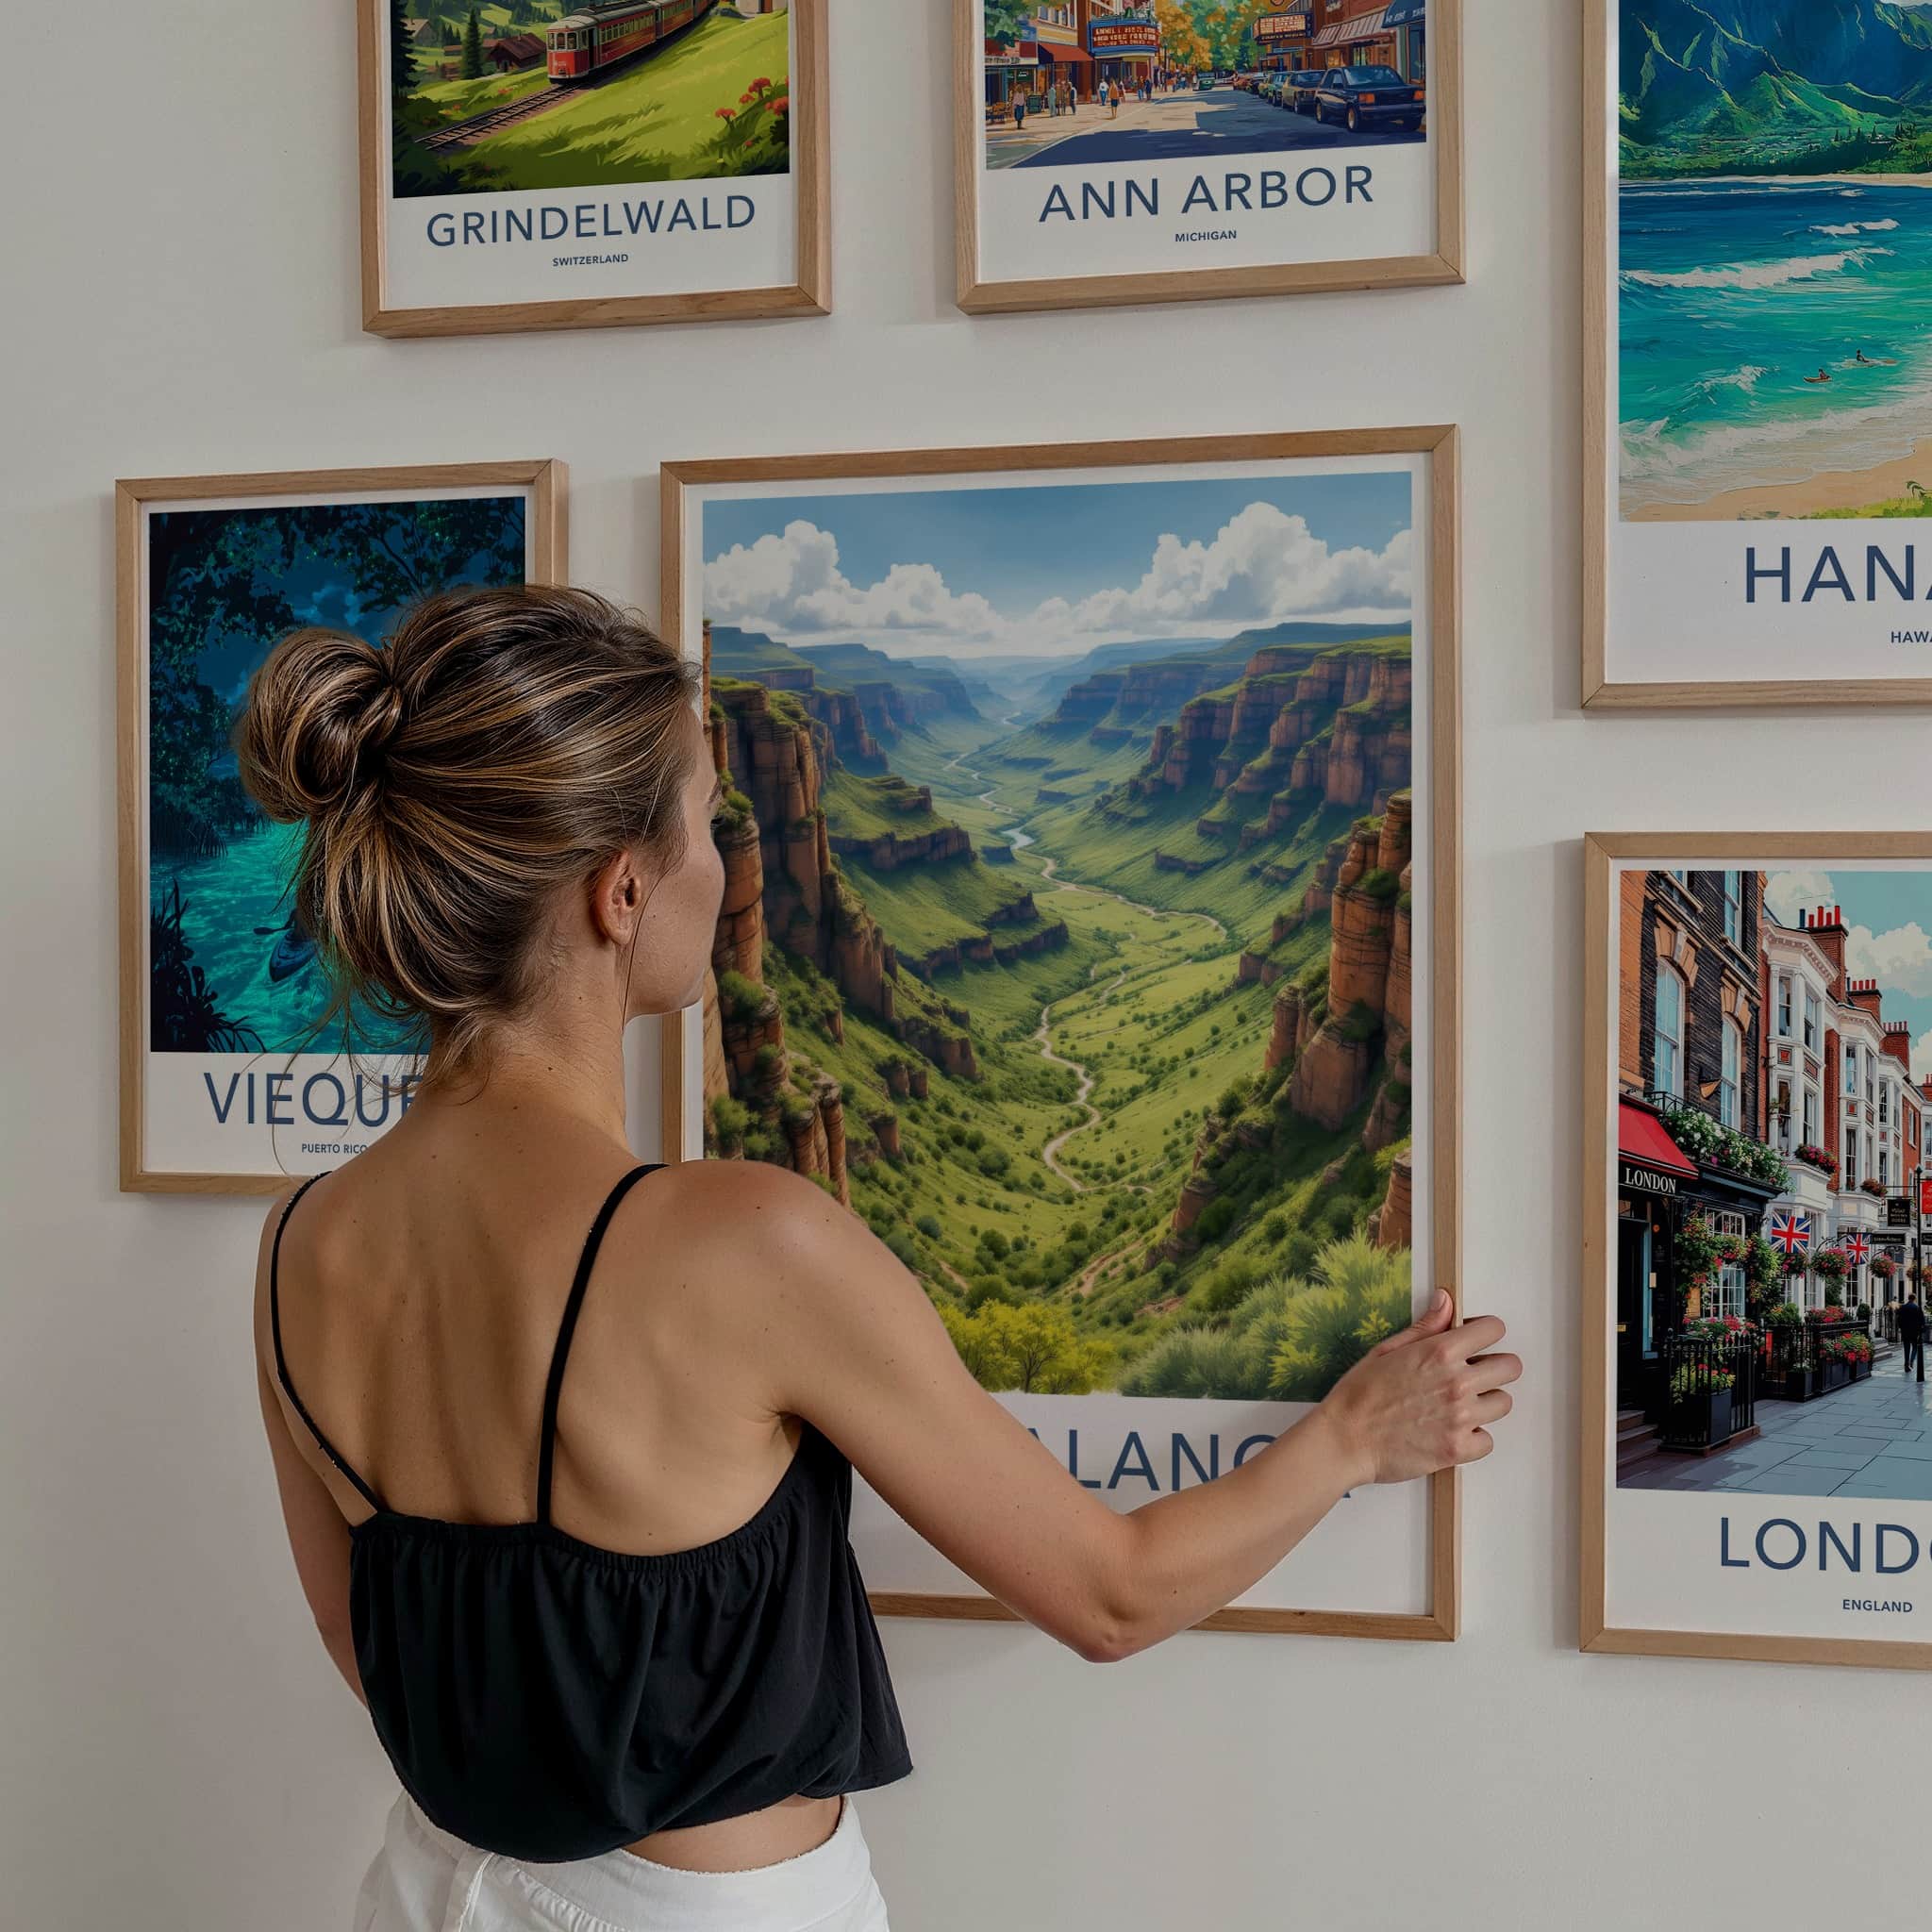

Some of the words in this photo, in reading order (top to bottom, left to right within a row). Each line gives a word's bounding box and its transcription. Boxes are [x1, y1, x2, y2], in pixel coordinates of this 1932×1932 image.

[1039, 177, 1159, 223] ANN
[1181, 165, 1374, 214] ARBOR
[426, 194, 756, 247] GRINDELWALD
[1174, 229, 1237, 242] MICHIGAN
[552, 253, 629, 267] SWITZERLAND
[1746, 544, 1932, 603] HAN
[1890, 630, 1932, 643] HAW
[302, 1143, 341, 1154] PUERTO
[343, 1144, 367, 1154] RICO
[1625, 1167, 1676, 1194] LONDON
[1722, 1517, 1932, 1574] LOND
[1842, 1598, 1913, 1613] ENGLAND
